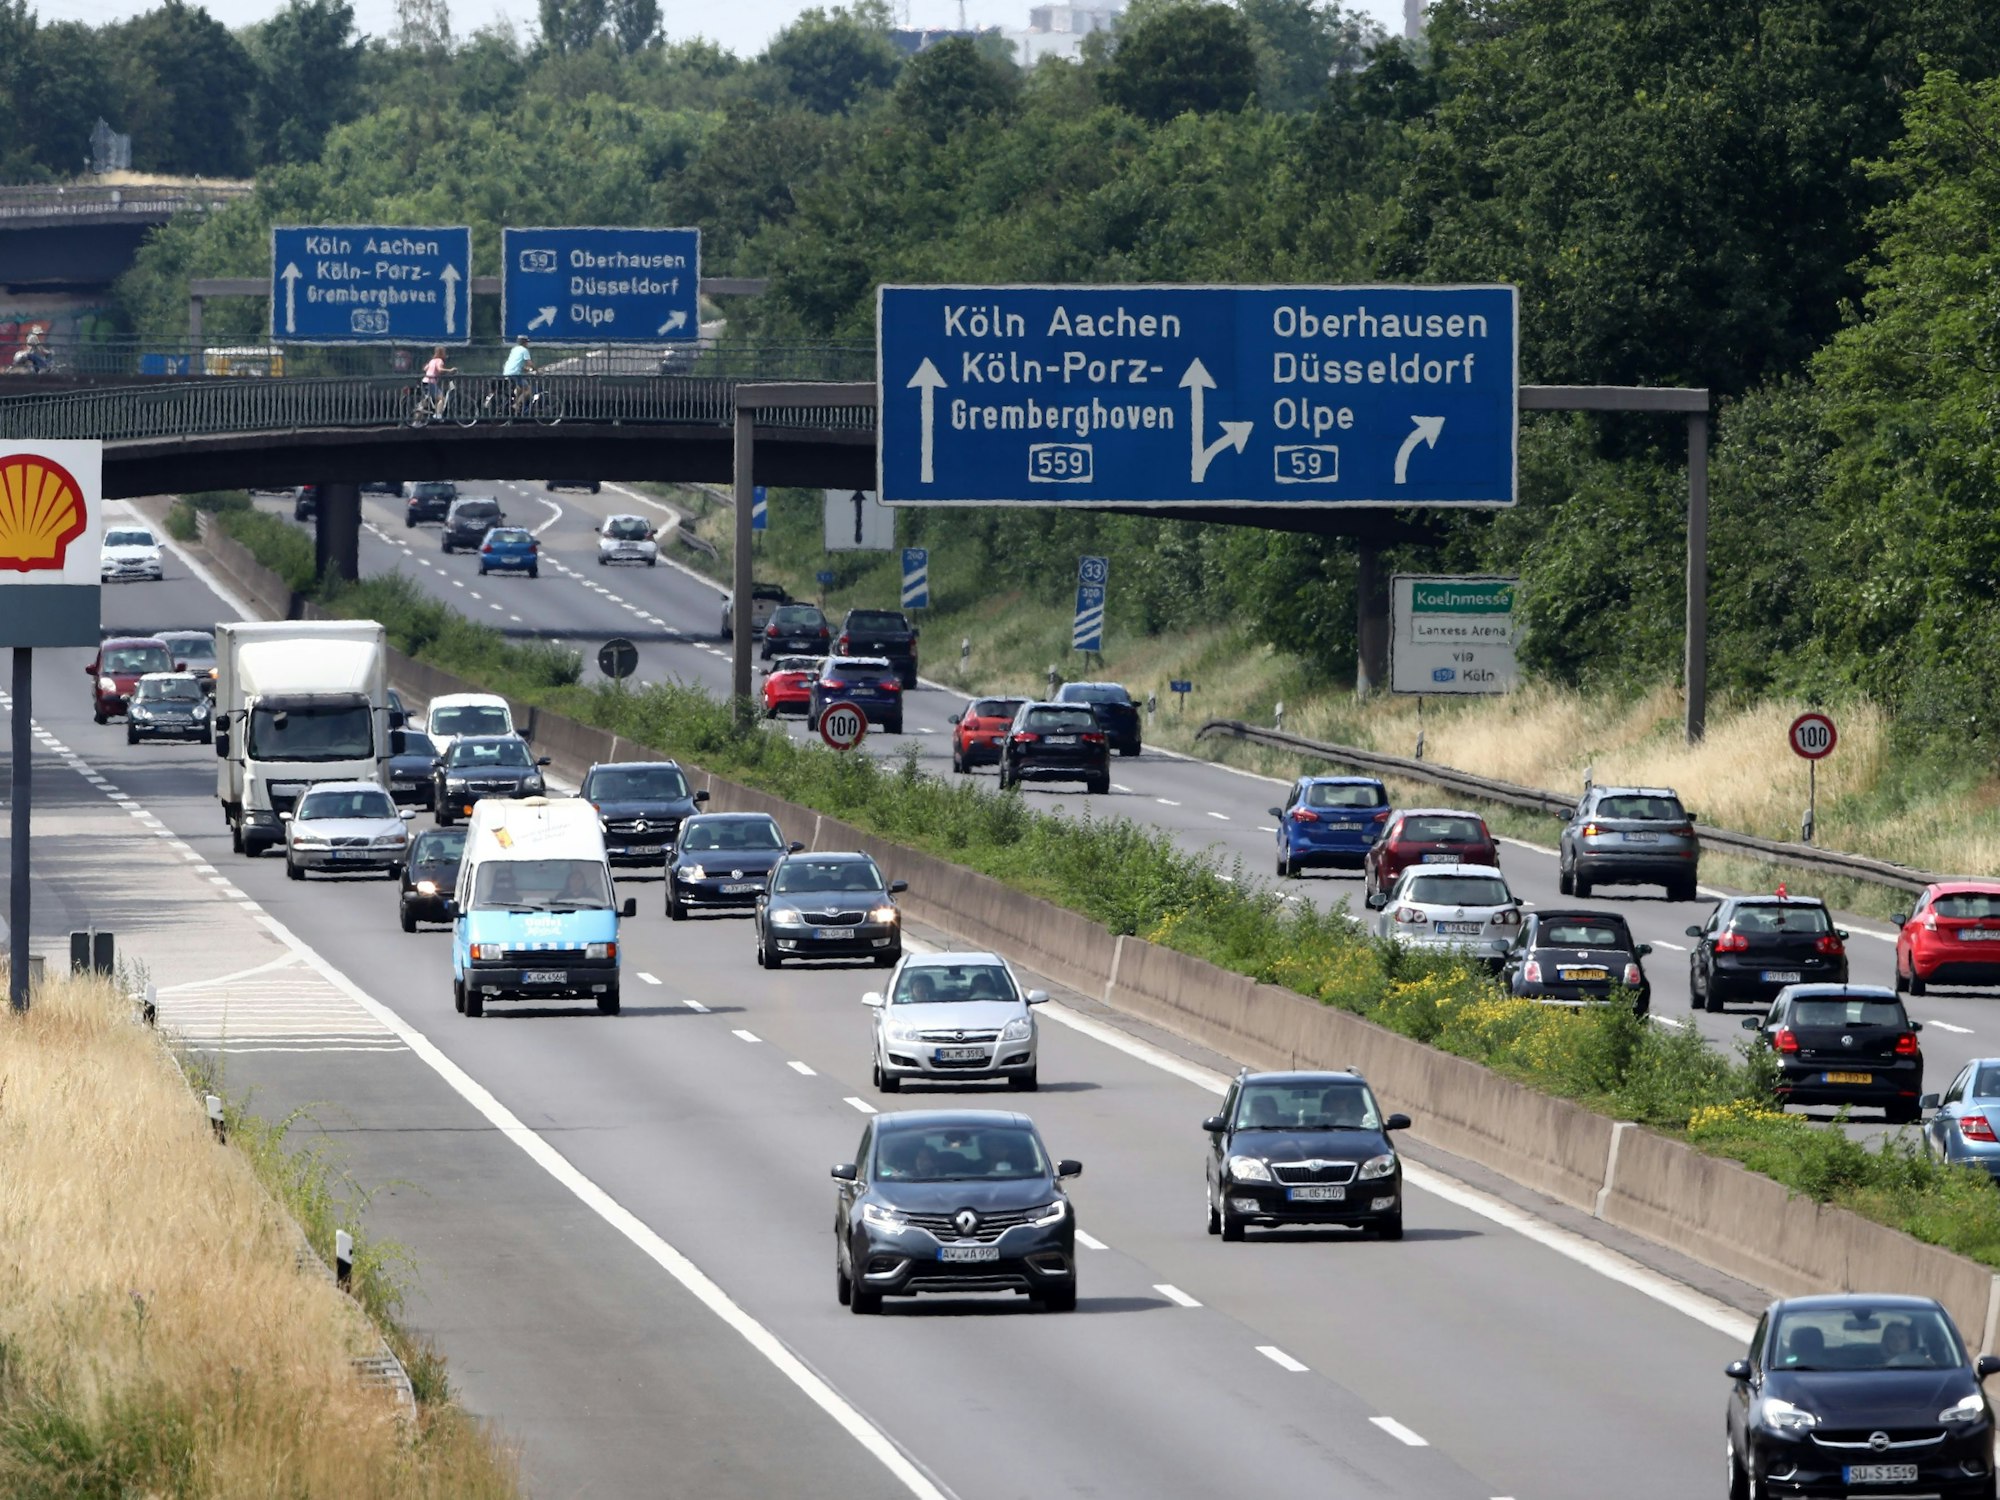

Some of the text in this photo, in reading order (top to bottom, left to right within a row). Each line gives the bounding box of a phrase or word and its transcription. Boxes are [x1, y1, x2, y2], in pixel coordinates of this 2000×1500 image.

[307, 237, 437, 255] Köln Aachen
[530, 253, 548, 267] 59
[571, 250, 685, 268] Oberhausen
[571, 276, 678, 295] Düsseldorf
[571, 305, 614, 326] Olpe
[944, 306, 1180, 337] Köln Aachen
[1273, 306, 1487, 338] Oberhausen
[963, 352, 1163, 384] Köln-Porz-
[1273, 352, 1474, 384] Düsseldorf
[951, 398, 1174, 438] Gremberghoven
[1273, 398, 1354, 438] Olpe
[1037, 452, 1083, 475] 559
[1290, 452, 1323, 475] 59
[1084, 563, 1102, 579] 33
[1417, 591, 1509, 606] Koelnmesse
[1418, 625, 1506, 637] Lanxess Arena
[1453, 652, 1474, 662] via
[1463, 669, 1495, 682] Köln
[830, 716, 857, 736] 100
[1799, 726, 1827, 747] 100
